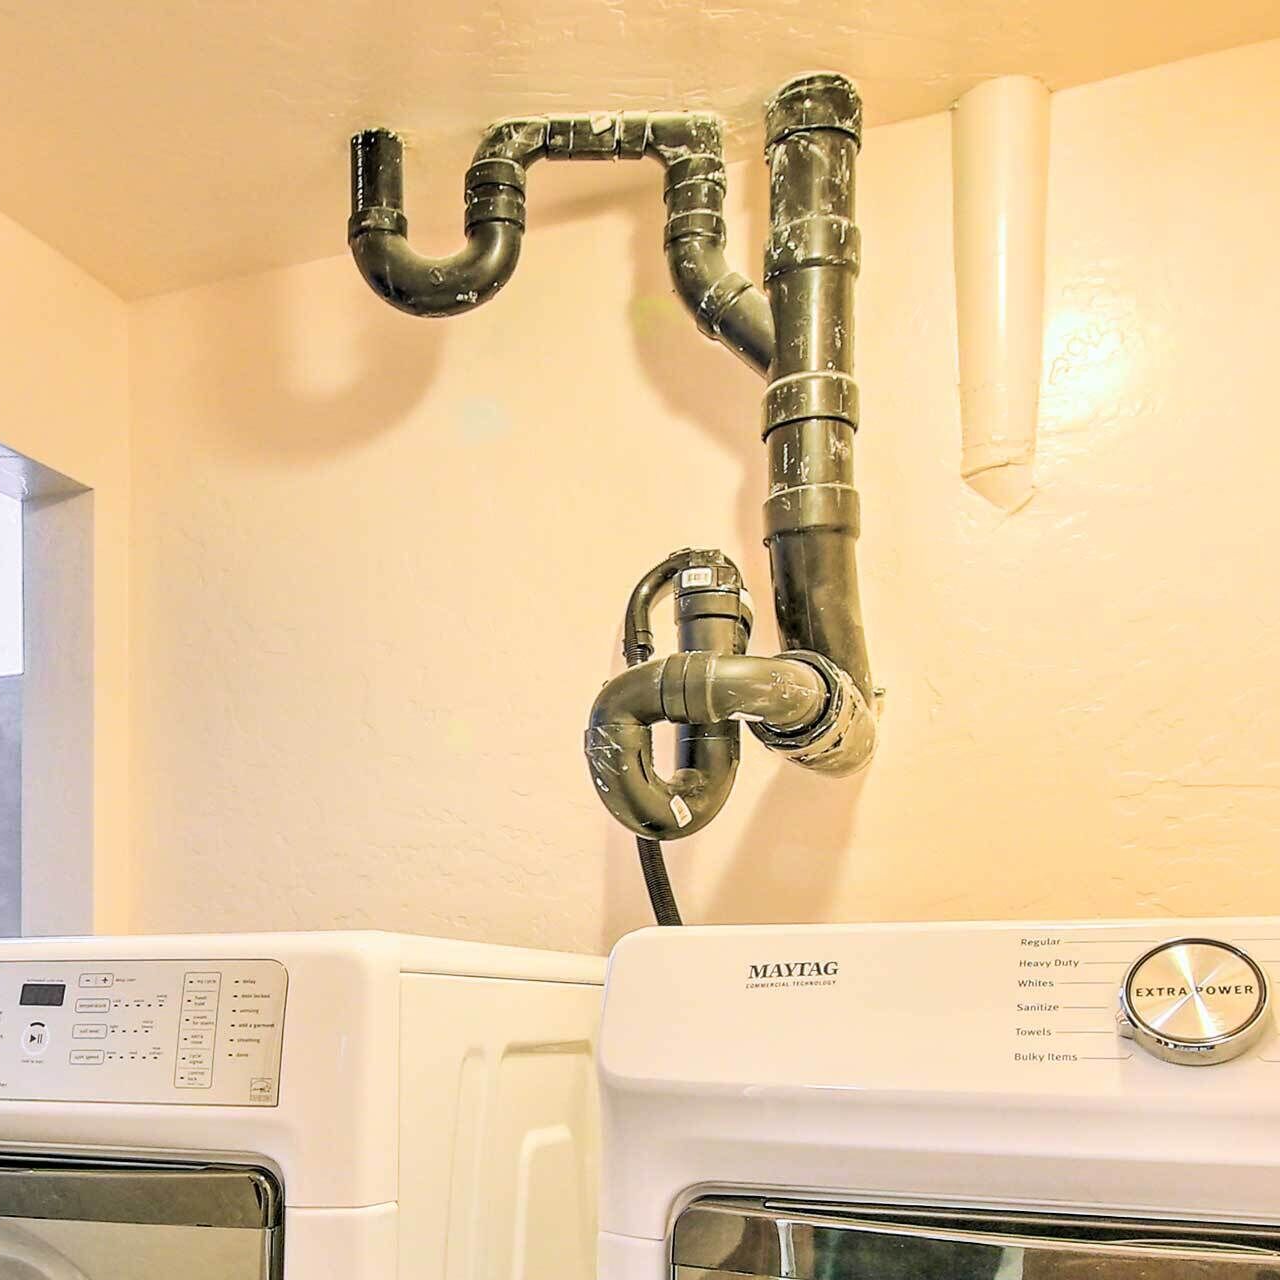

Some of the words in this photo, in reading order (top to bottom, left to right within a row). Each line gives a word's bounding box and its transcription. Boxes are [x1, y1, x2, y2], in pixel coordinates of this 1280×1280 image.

[1020, 938, 1061, 948] Regular
[1019, 960, 1052, 968] Heavy
[1054, 959, 1080, 968] Duty
[748, 961, 839, 979] MAYTAG
[1017, 980, 1055, 988] Whites
[1136, 987, 1188, 997] EXTRA
[1195, 985, 1254, 995] POWER
[1016, 1003, 1060, 1012] Sanitize
[1016, 1028, 1052, 1037] Towels
[1014, 1052, 1045, 1062] Bulky
[1048, 1052, 1078, 1062] Items
